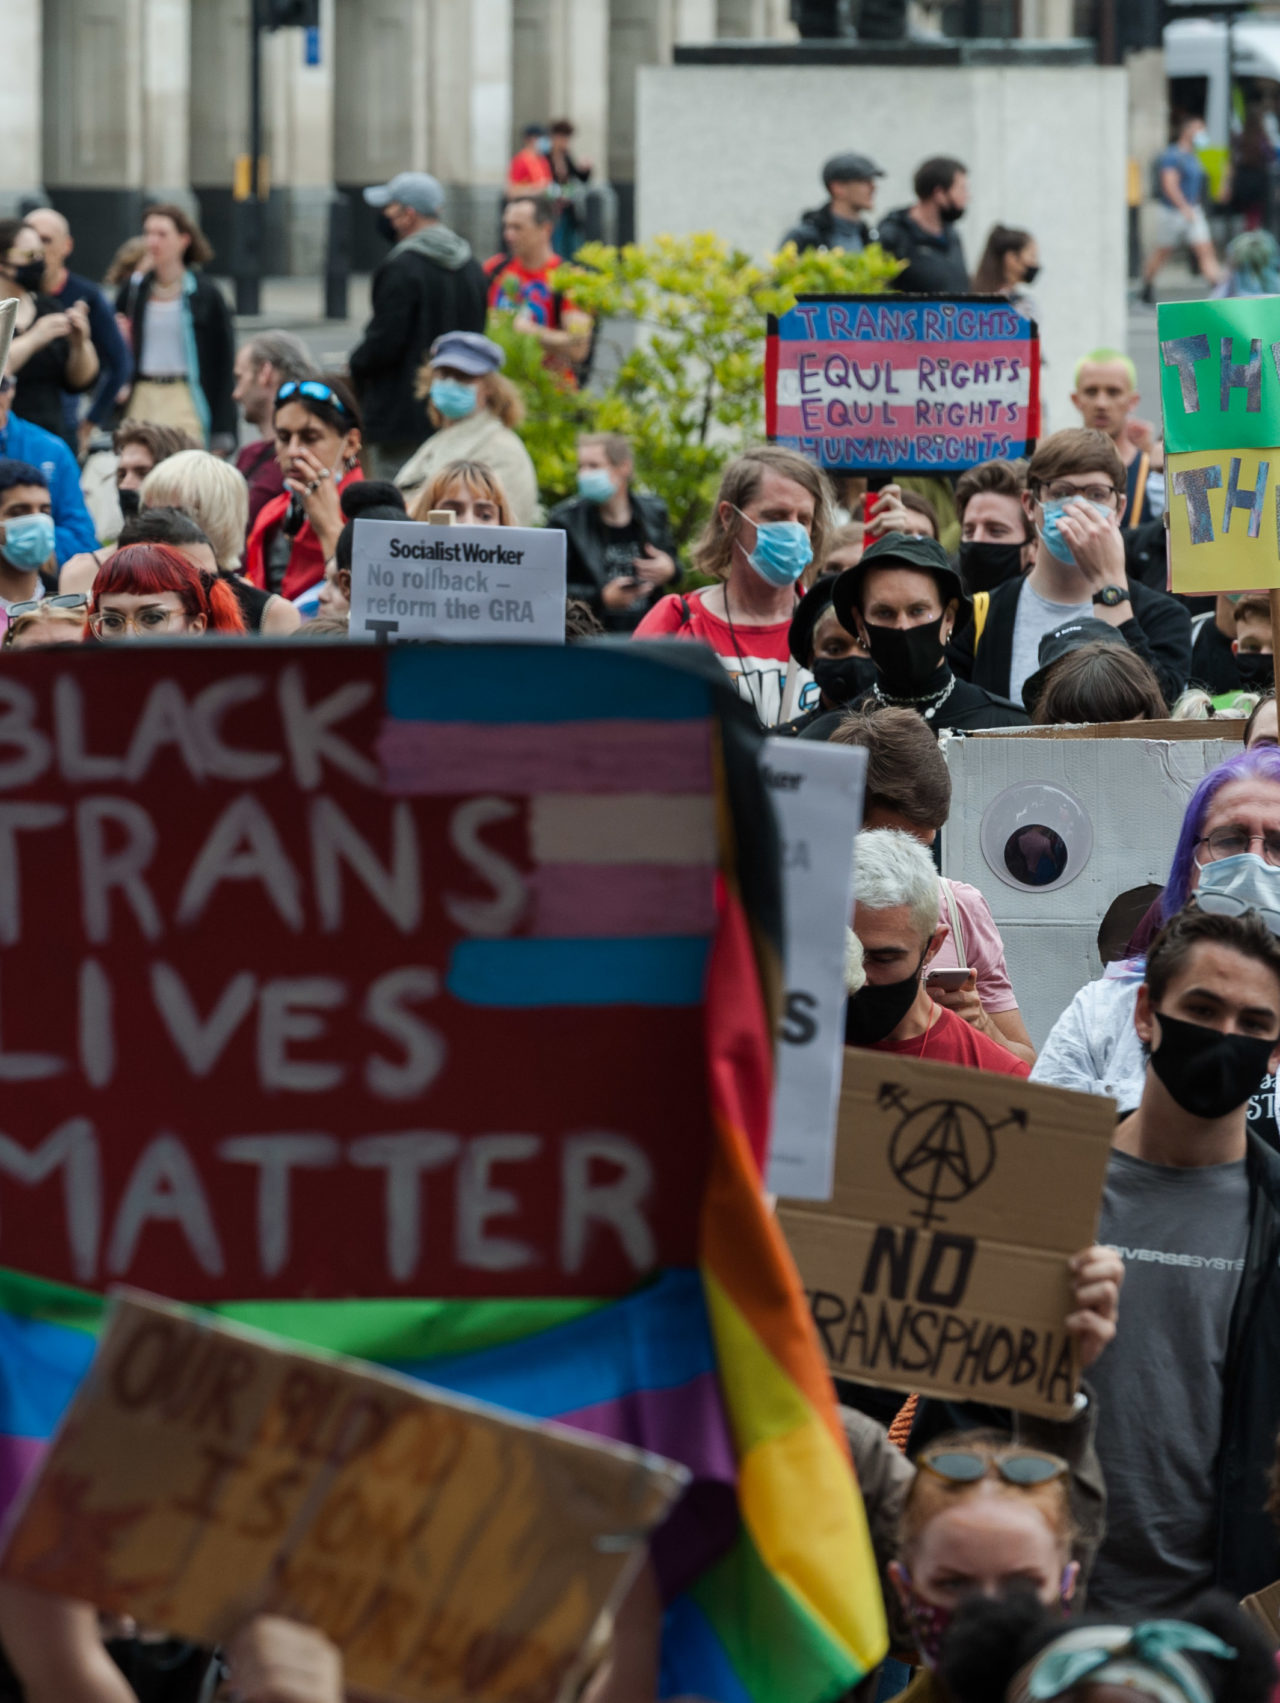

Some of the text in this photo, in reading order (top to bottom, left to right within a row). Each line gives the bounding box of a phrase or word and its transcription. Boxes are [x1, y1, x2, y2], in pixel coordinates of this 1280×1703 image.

[796, 305, 918, 341] TRANS
[798, 352, 899, 395] EQUL
[1160, 333, 1280, 415] TH
[800, 398, 897, 432] EQUL
[1171, 456, 1280, 562] TH
[389, 537, 525, 566] Socialist Worker
[367, 563, 395, 588] No
[401, 566, 489, 593] rollback
[366, 593, 535, 624] reform the GRA
[861, 1226, 977, 1309] NO
[808, 1288, 1071, 1404] RANSPHOBIA
